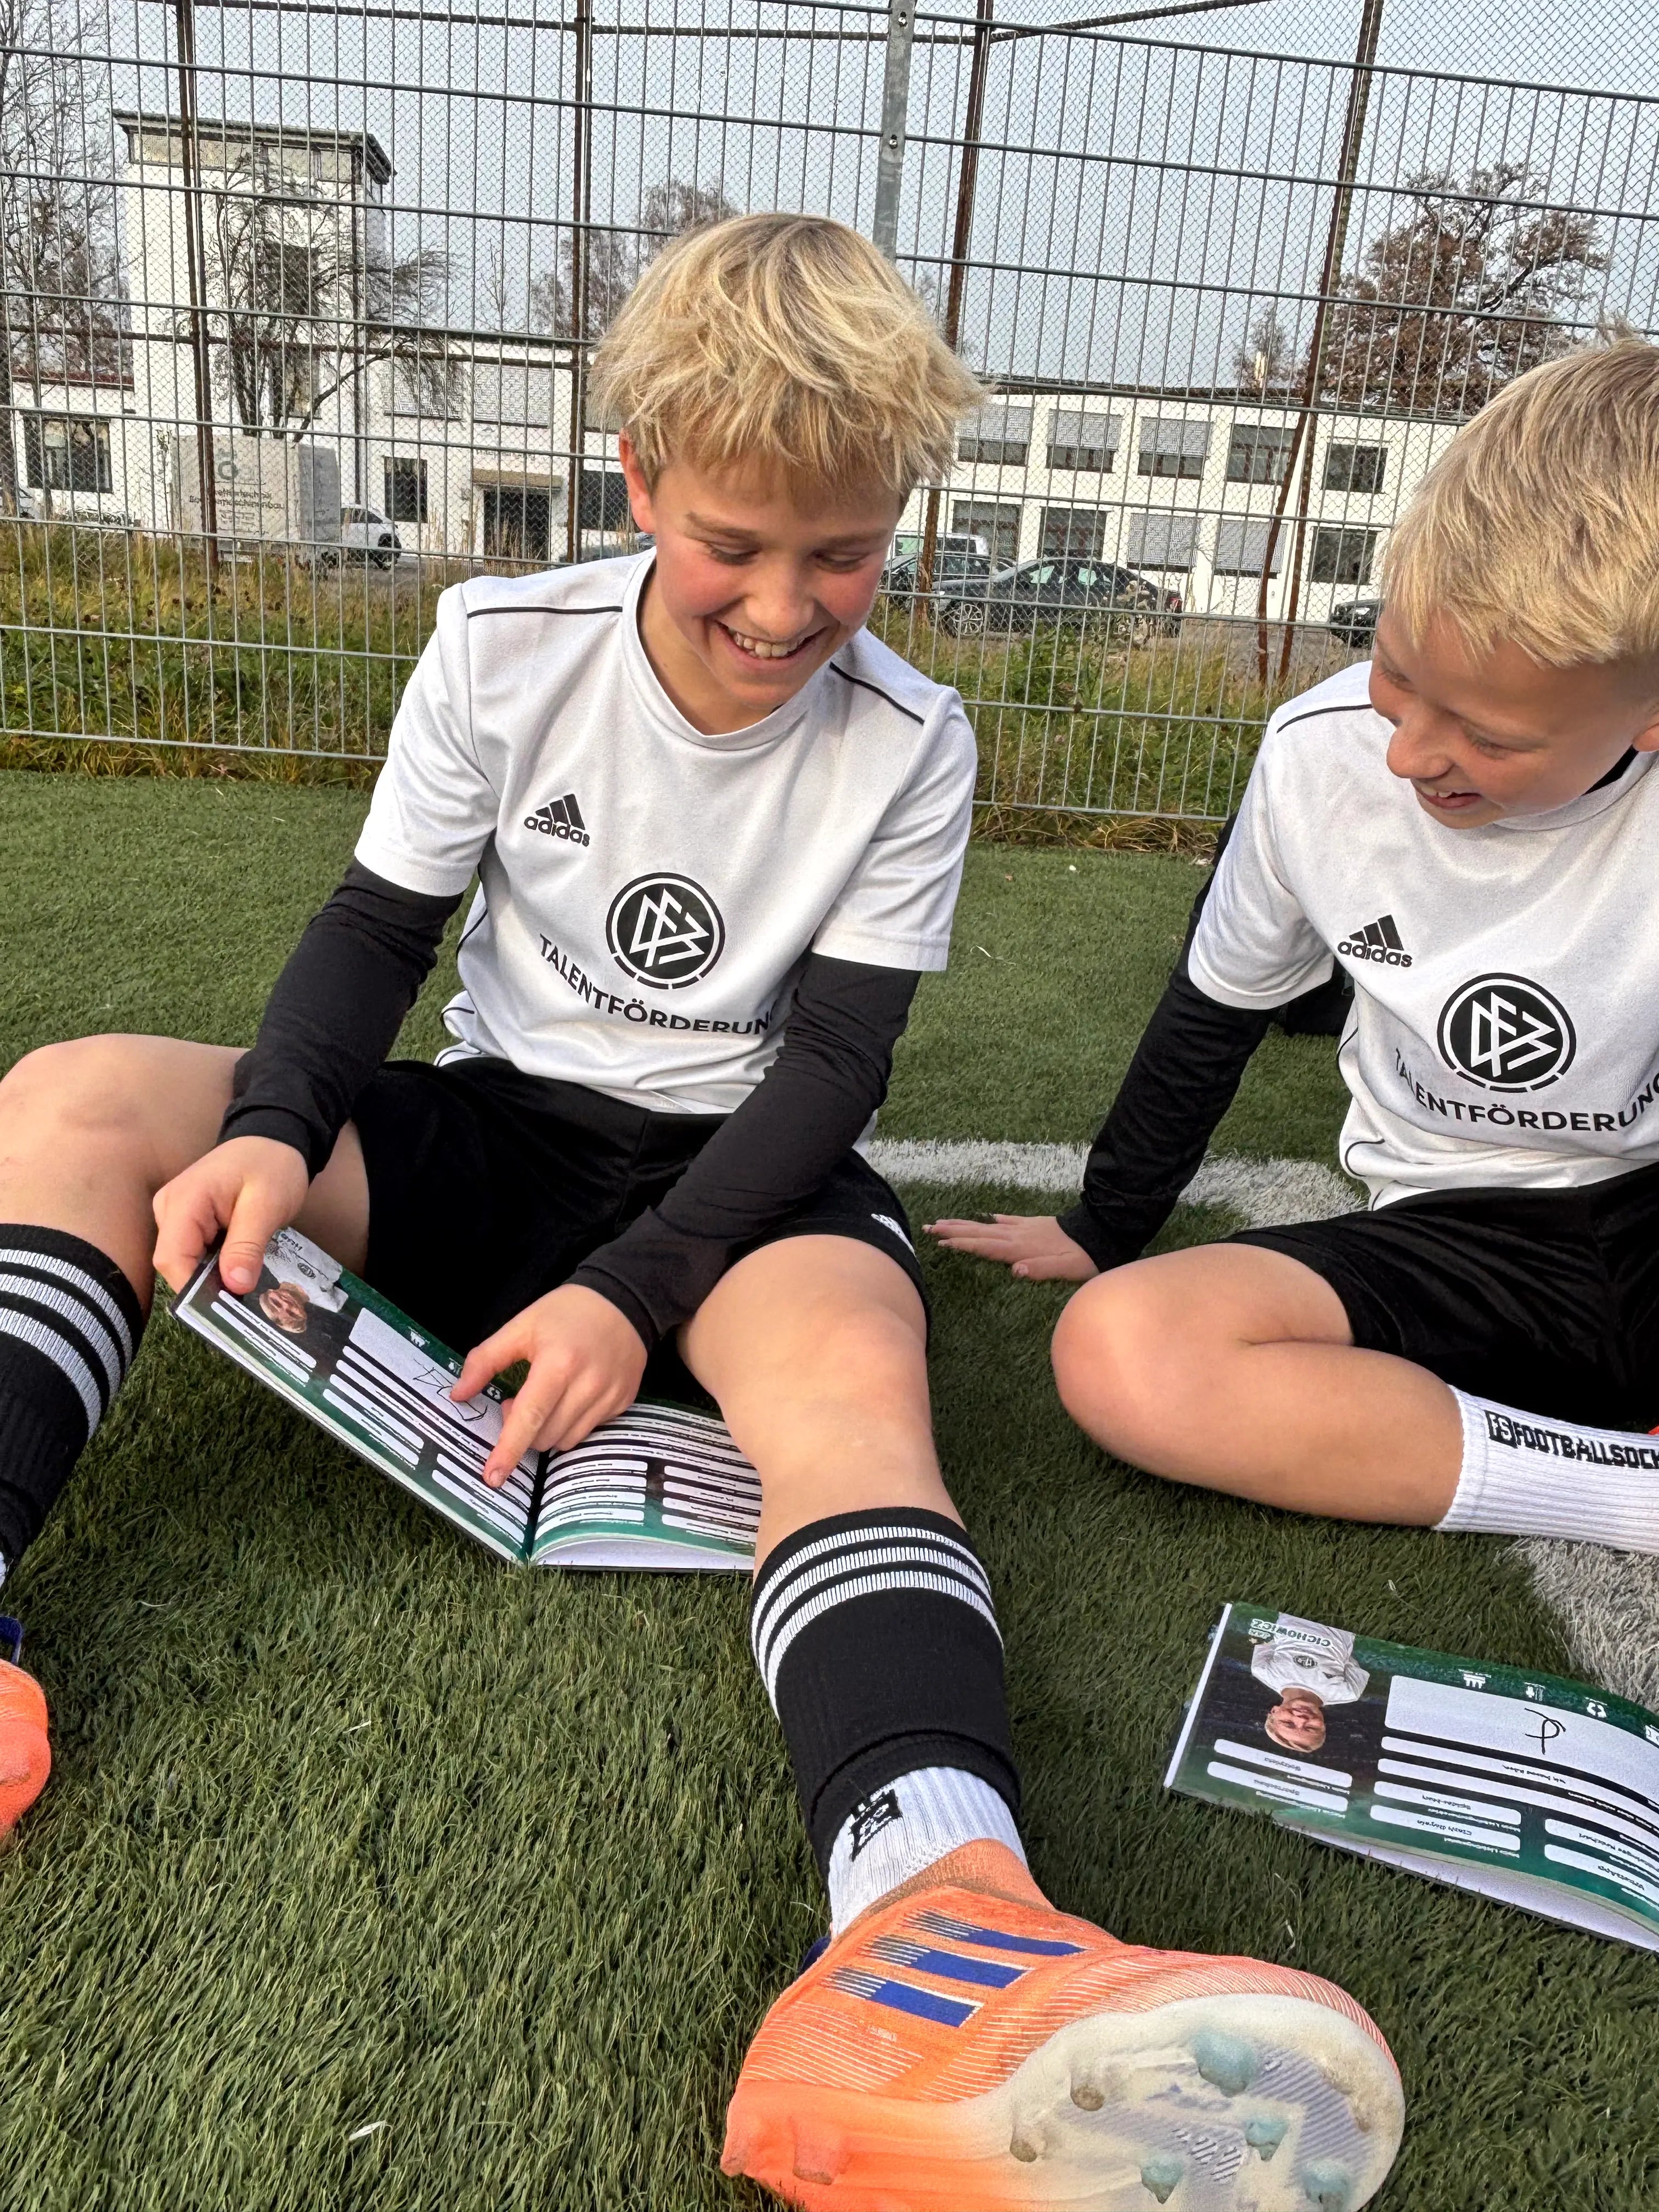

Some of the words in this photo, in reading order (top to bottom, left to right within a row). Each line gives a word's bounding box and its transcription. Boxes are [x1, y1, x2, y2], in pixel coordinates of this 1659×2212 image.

[524, 816, 590, 847] adidas
[1337, 940, 1413, 968] adidas
[539, 933, 774, 1035] TALENTFÖRDERUN
